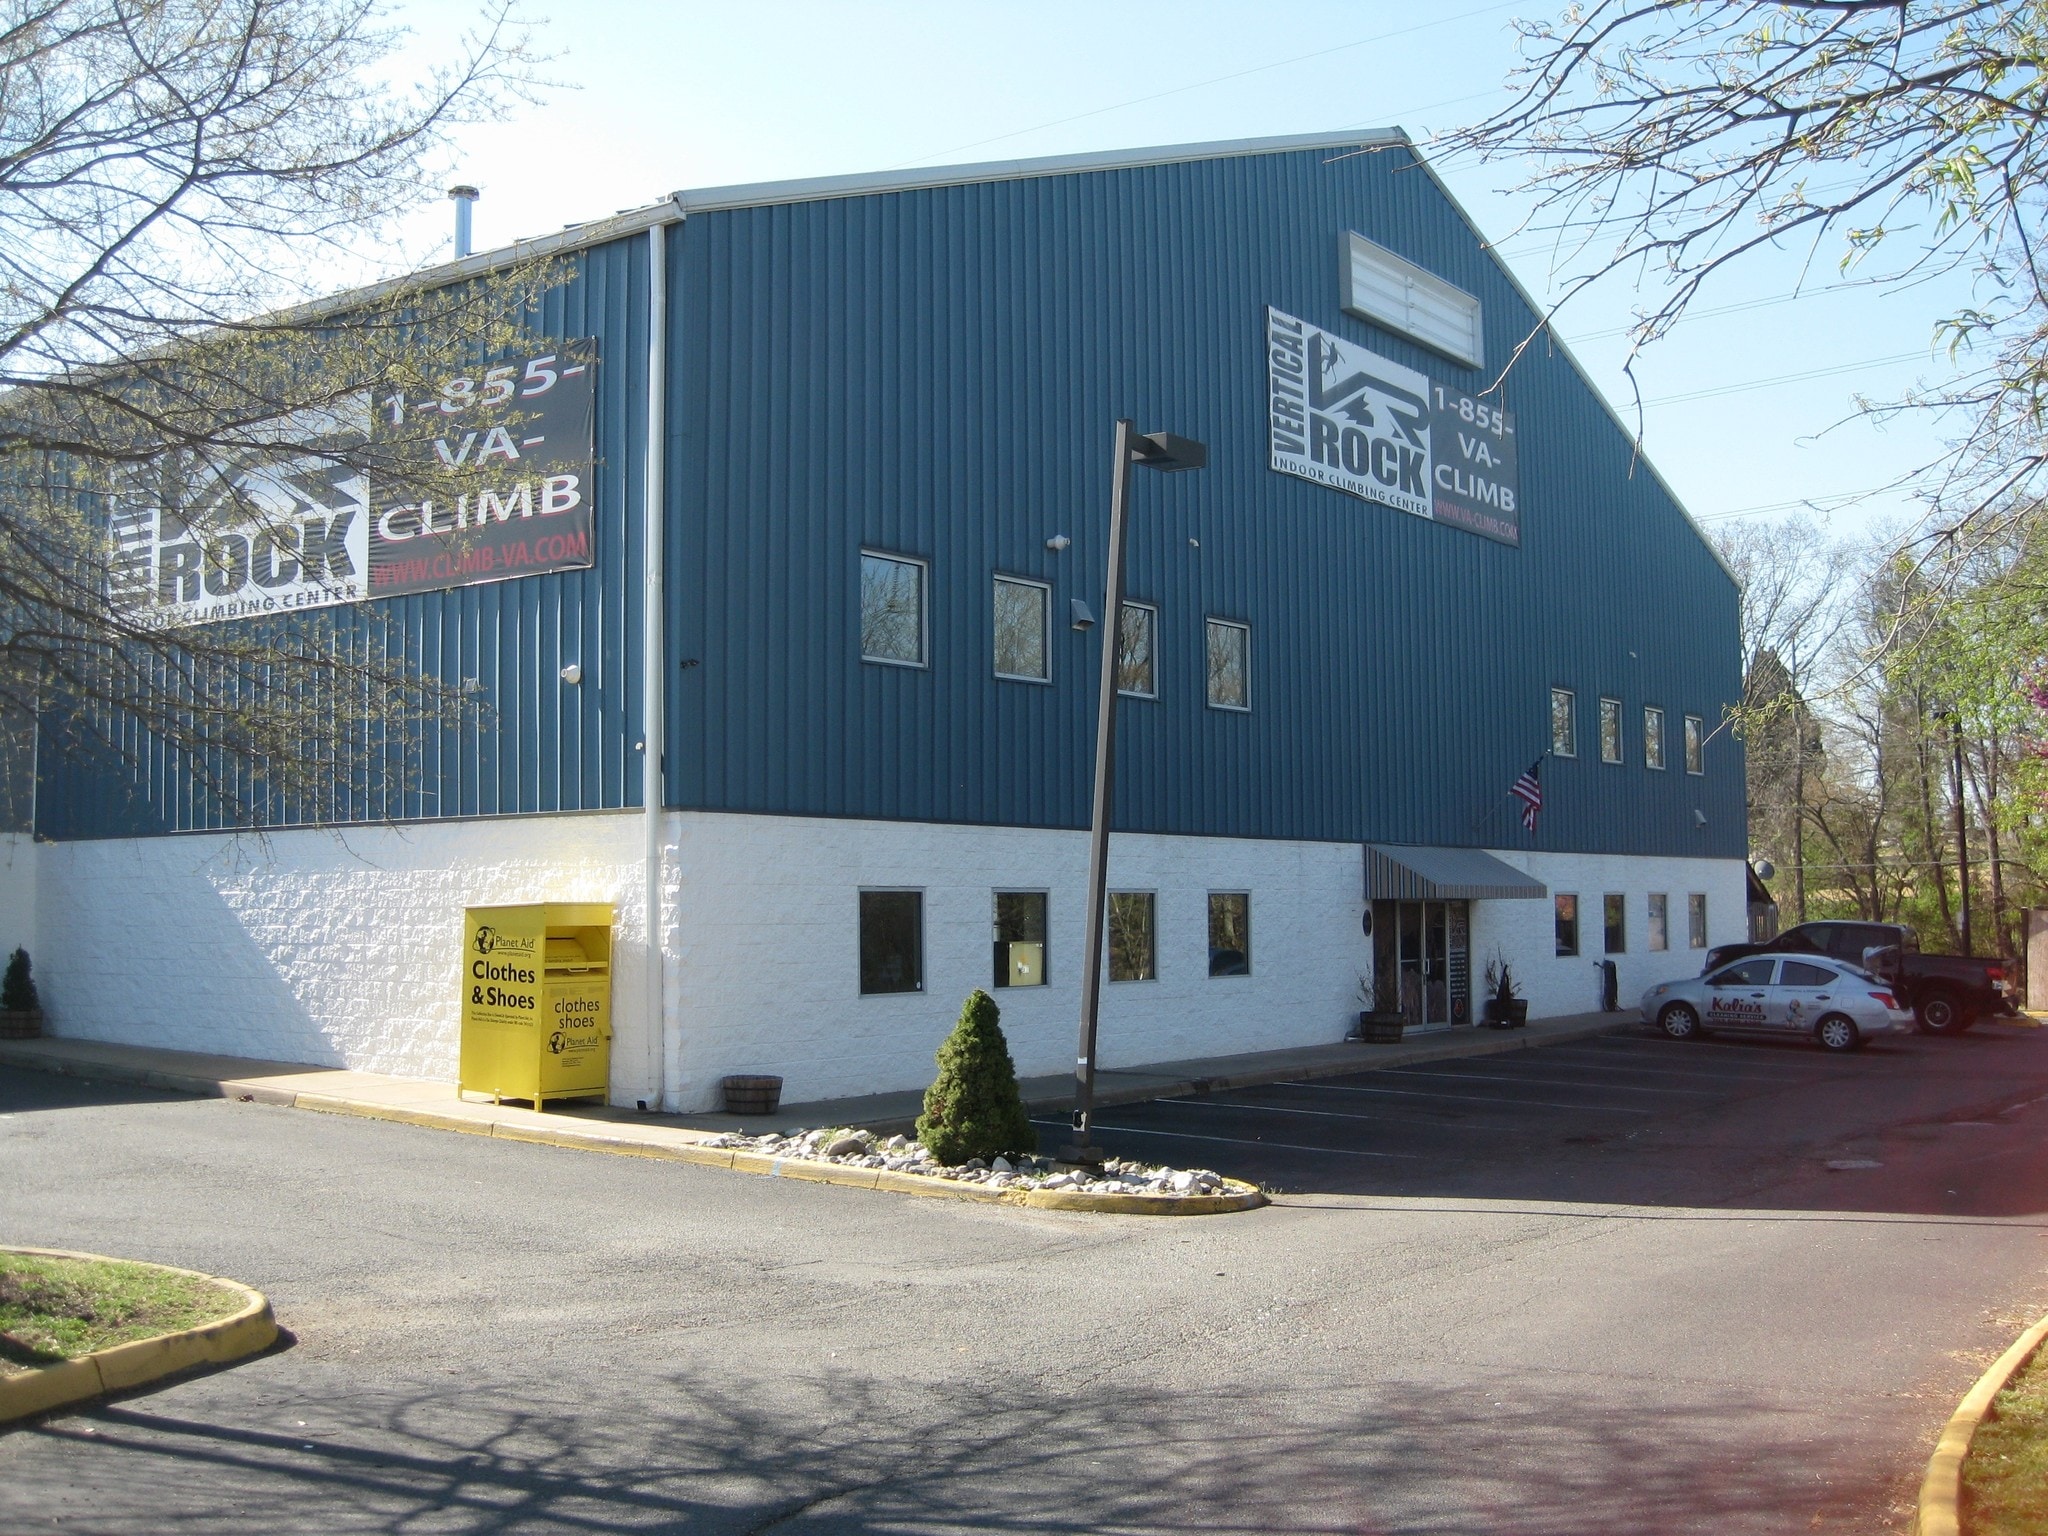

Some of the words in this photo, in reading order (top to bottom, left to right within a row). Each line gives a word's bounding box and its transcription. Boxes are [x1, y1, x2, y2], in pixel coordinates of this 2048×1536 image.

[385, 354, 585, 425] 1-855-
[1271, 316, 1306, 456] VERTICAL
[1434, 386, 1514, 434] 1-855-
[434, 427, 545, 470] VA-
[1309, 412, 1427, 499] ROCK
[1457, 432, 1501, 468] VA-
[1273, 455, 1325, 482] INDOOR
[1329, 474, 1386, 502] CLIMBING
[1388, 494, 1428, 516] CENTER
[1434, 464, 1516, 512] CLIMB
[378, 474, 582, 541] CLIMB
[1433, 498, 1518, 541] WWW.VA-CLIMB.COM
[159, 509, 357, 607] ROCK
[373, 531, 587, 587] WWW.CLIMB-VA.COM
[183, 596, 275, 622] CLIMBING
[283, 584, 358, 608] CENTER
[495, 935, 518, 947] Planet
[520, 937, 535, 949] Aid
[472, 960, 535, 984] Clothes
[554, 997, 600, 1014] clothes
[559, 1013, 595, 1029] shoes
[1711, 996, 1762, 1013] Kalia's
[567, 1037, 585, 1046] Planet
[587, 1035, 599, 1045] Aid
